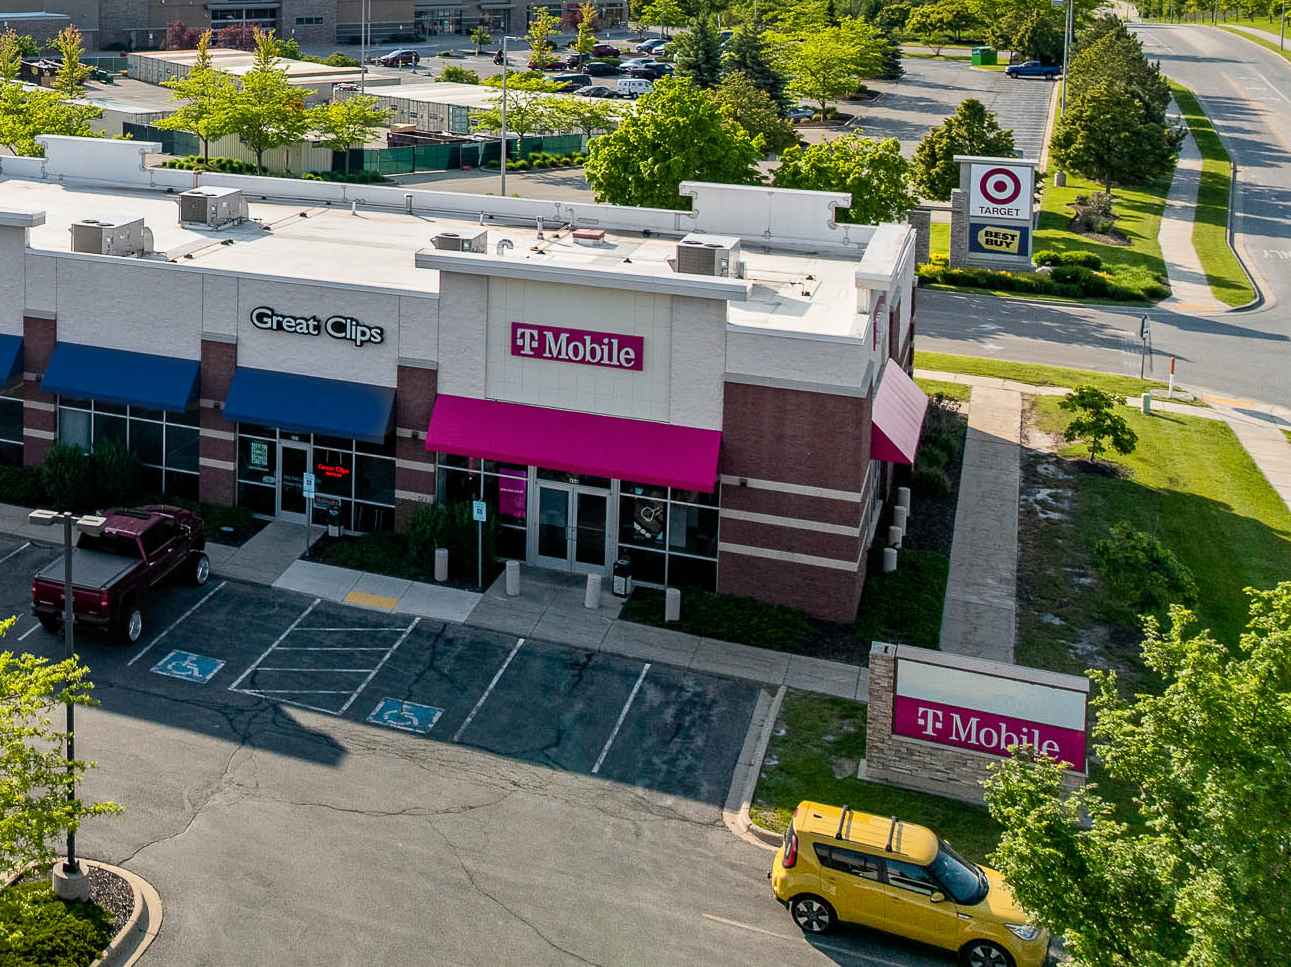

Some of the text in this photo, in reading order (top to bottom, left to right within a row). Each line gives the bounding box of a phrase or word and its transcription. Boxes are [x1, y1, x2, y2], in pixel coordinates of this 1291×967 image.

[979, 206, 1020, 216] TARGET
[984, 230, 1018, 241] BEST
[985, 238, 1013, 248] BUY
[250, 306, 384, 347] Great Clips
[542, 331, 636, 367] Mobile
